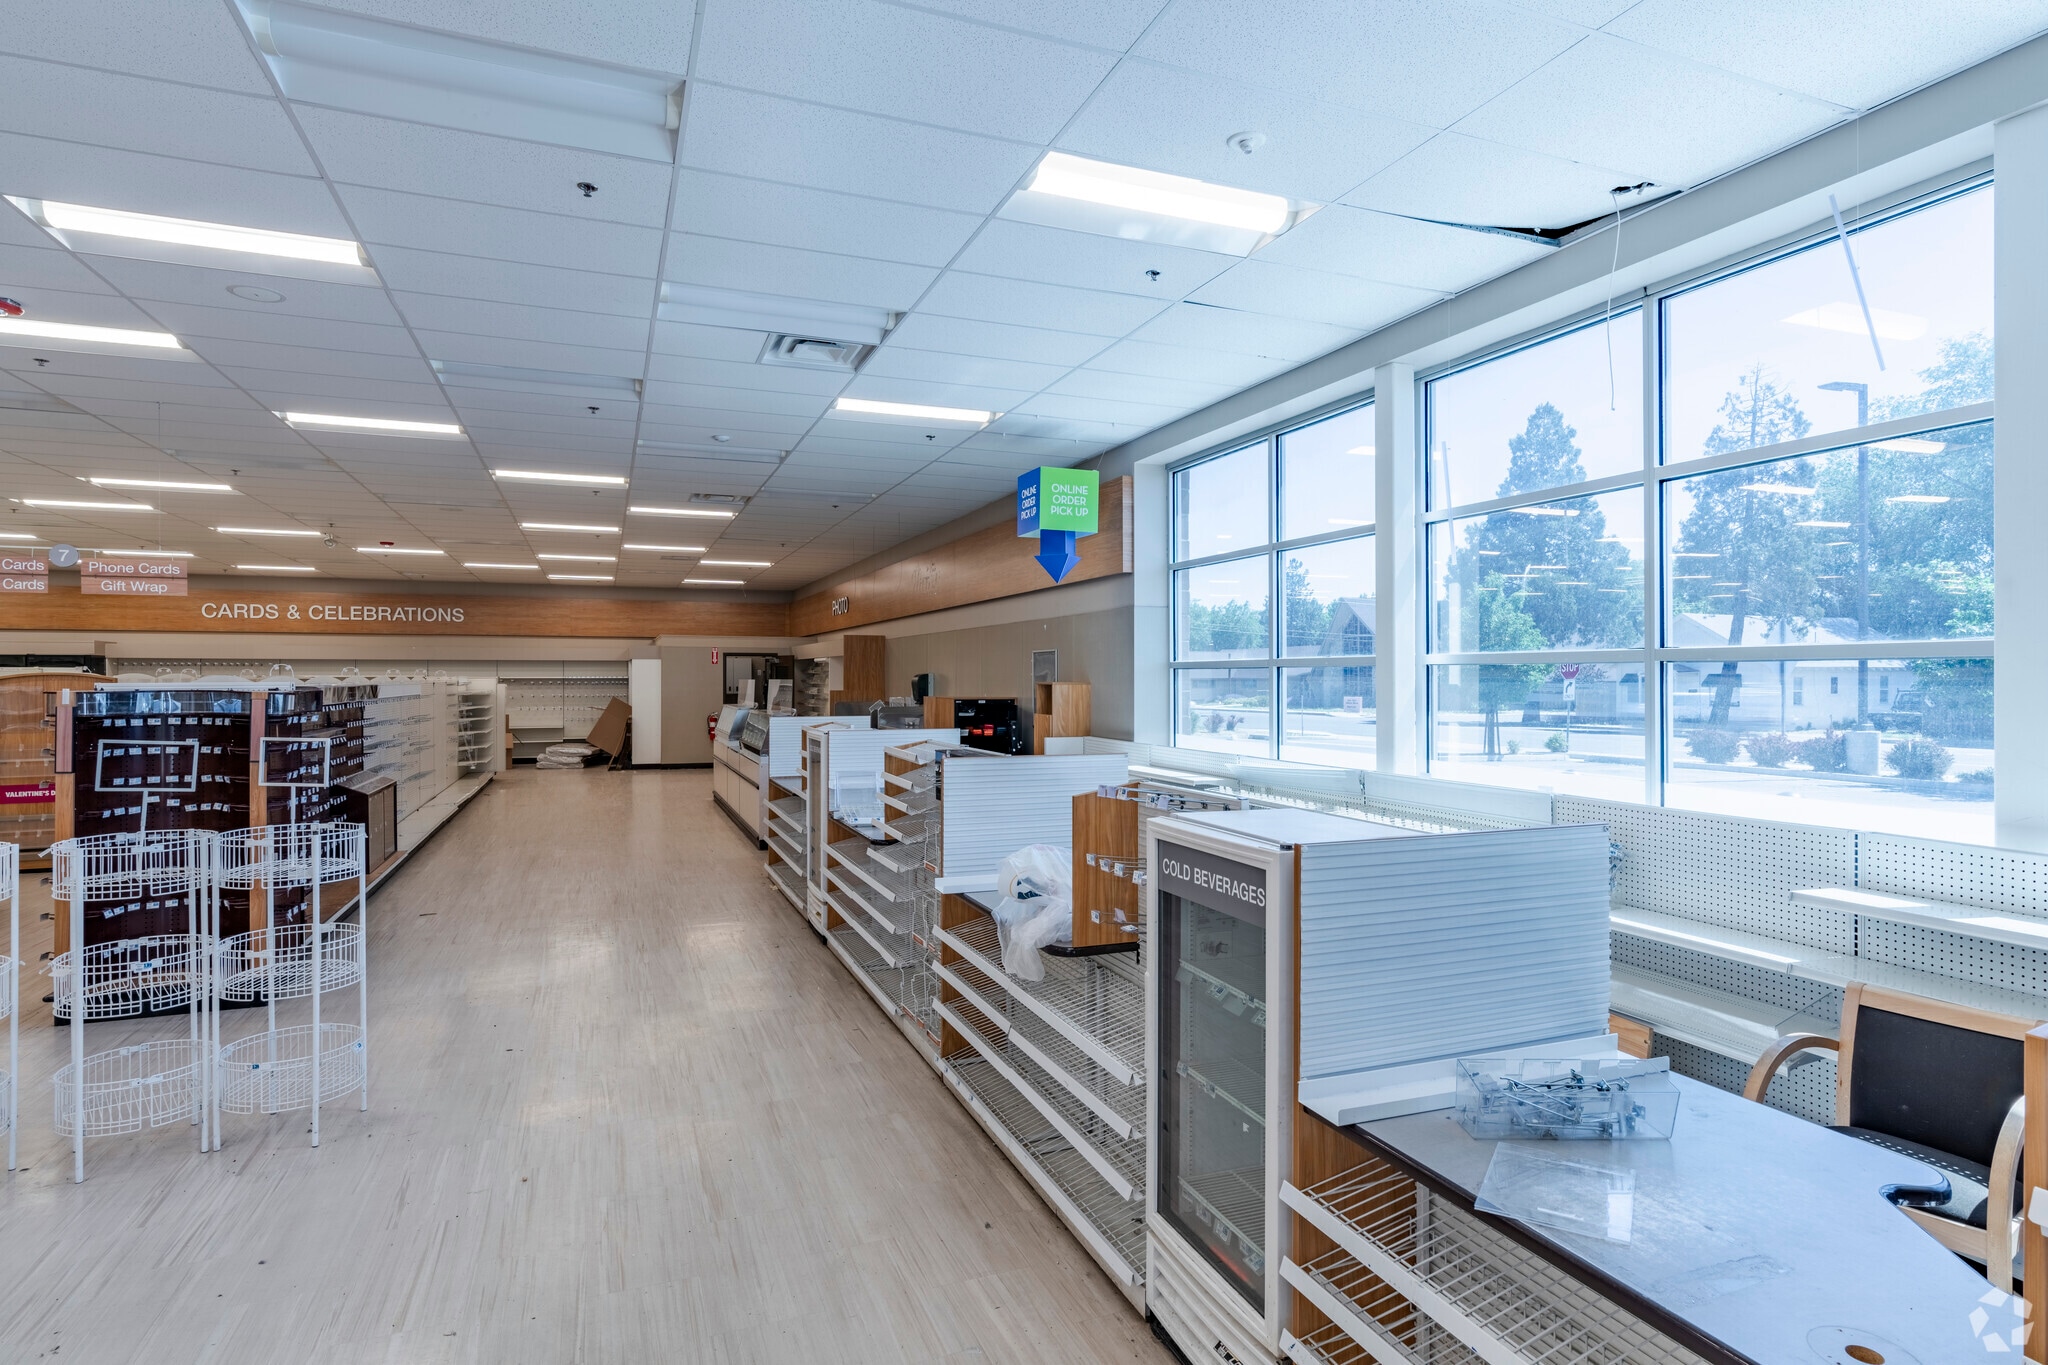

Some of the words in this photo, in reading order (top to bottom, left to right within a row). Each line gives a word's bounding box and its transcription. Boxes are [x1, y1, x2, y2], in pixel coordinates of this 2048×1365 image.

[1021, 485, 1037, 499] ONLINE
[1051, 483, 1089, 495] ONLINE
[1021, 496, 1036, 510] ORDER
[1052, 495, 1087, 506] ORDER
[1020, 509, 1031, 521] PICK
[1031, 507, 1037, 517] UP
[1051, 505, 1073, 516] PICK
[1075, 507, 1089, 517] UP
[58, 550, 69, 562] 7
[2, 558, 45, 571] Cards
[88, 561, 135, 574] Phone
[138, 563, 181, 575] Cards
[2, 578, 45, 591] Cards
[101, 580, 127, 592] Gift
[131, 581, 168, 595] Wrap
[201, 602, 280, 619] CARDS
[286, 604, 301, 620] &
[308, 604, 466, 623] CELEBRATIONS
[832, 596, 849, 616] PHOTO
[1162, 858, 1191, 881] COLD
[1193, 867, 1266, 907] BEVERAGES
